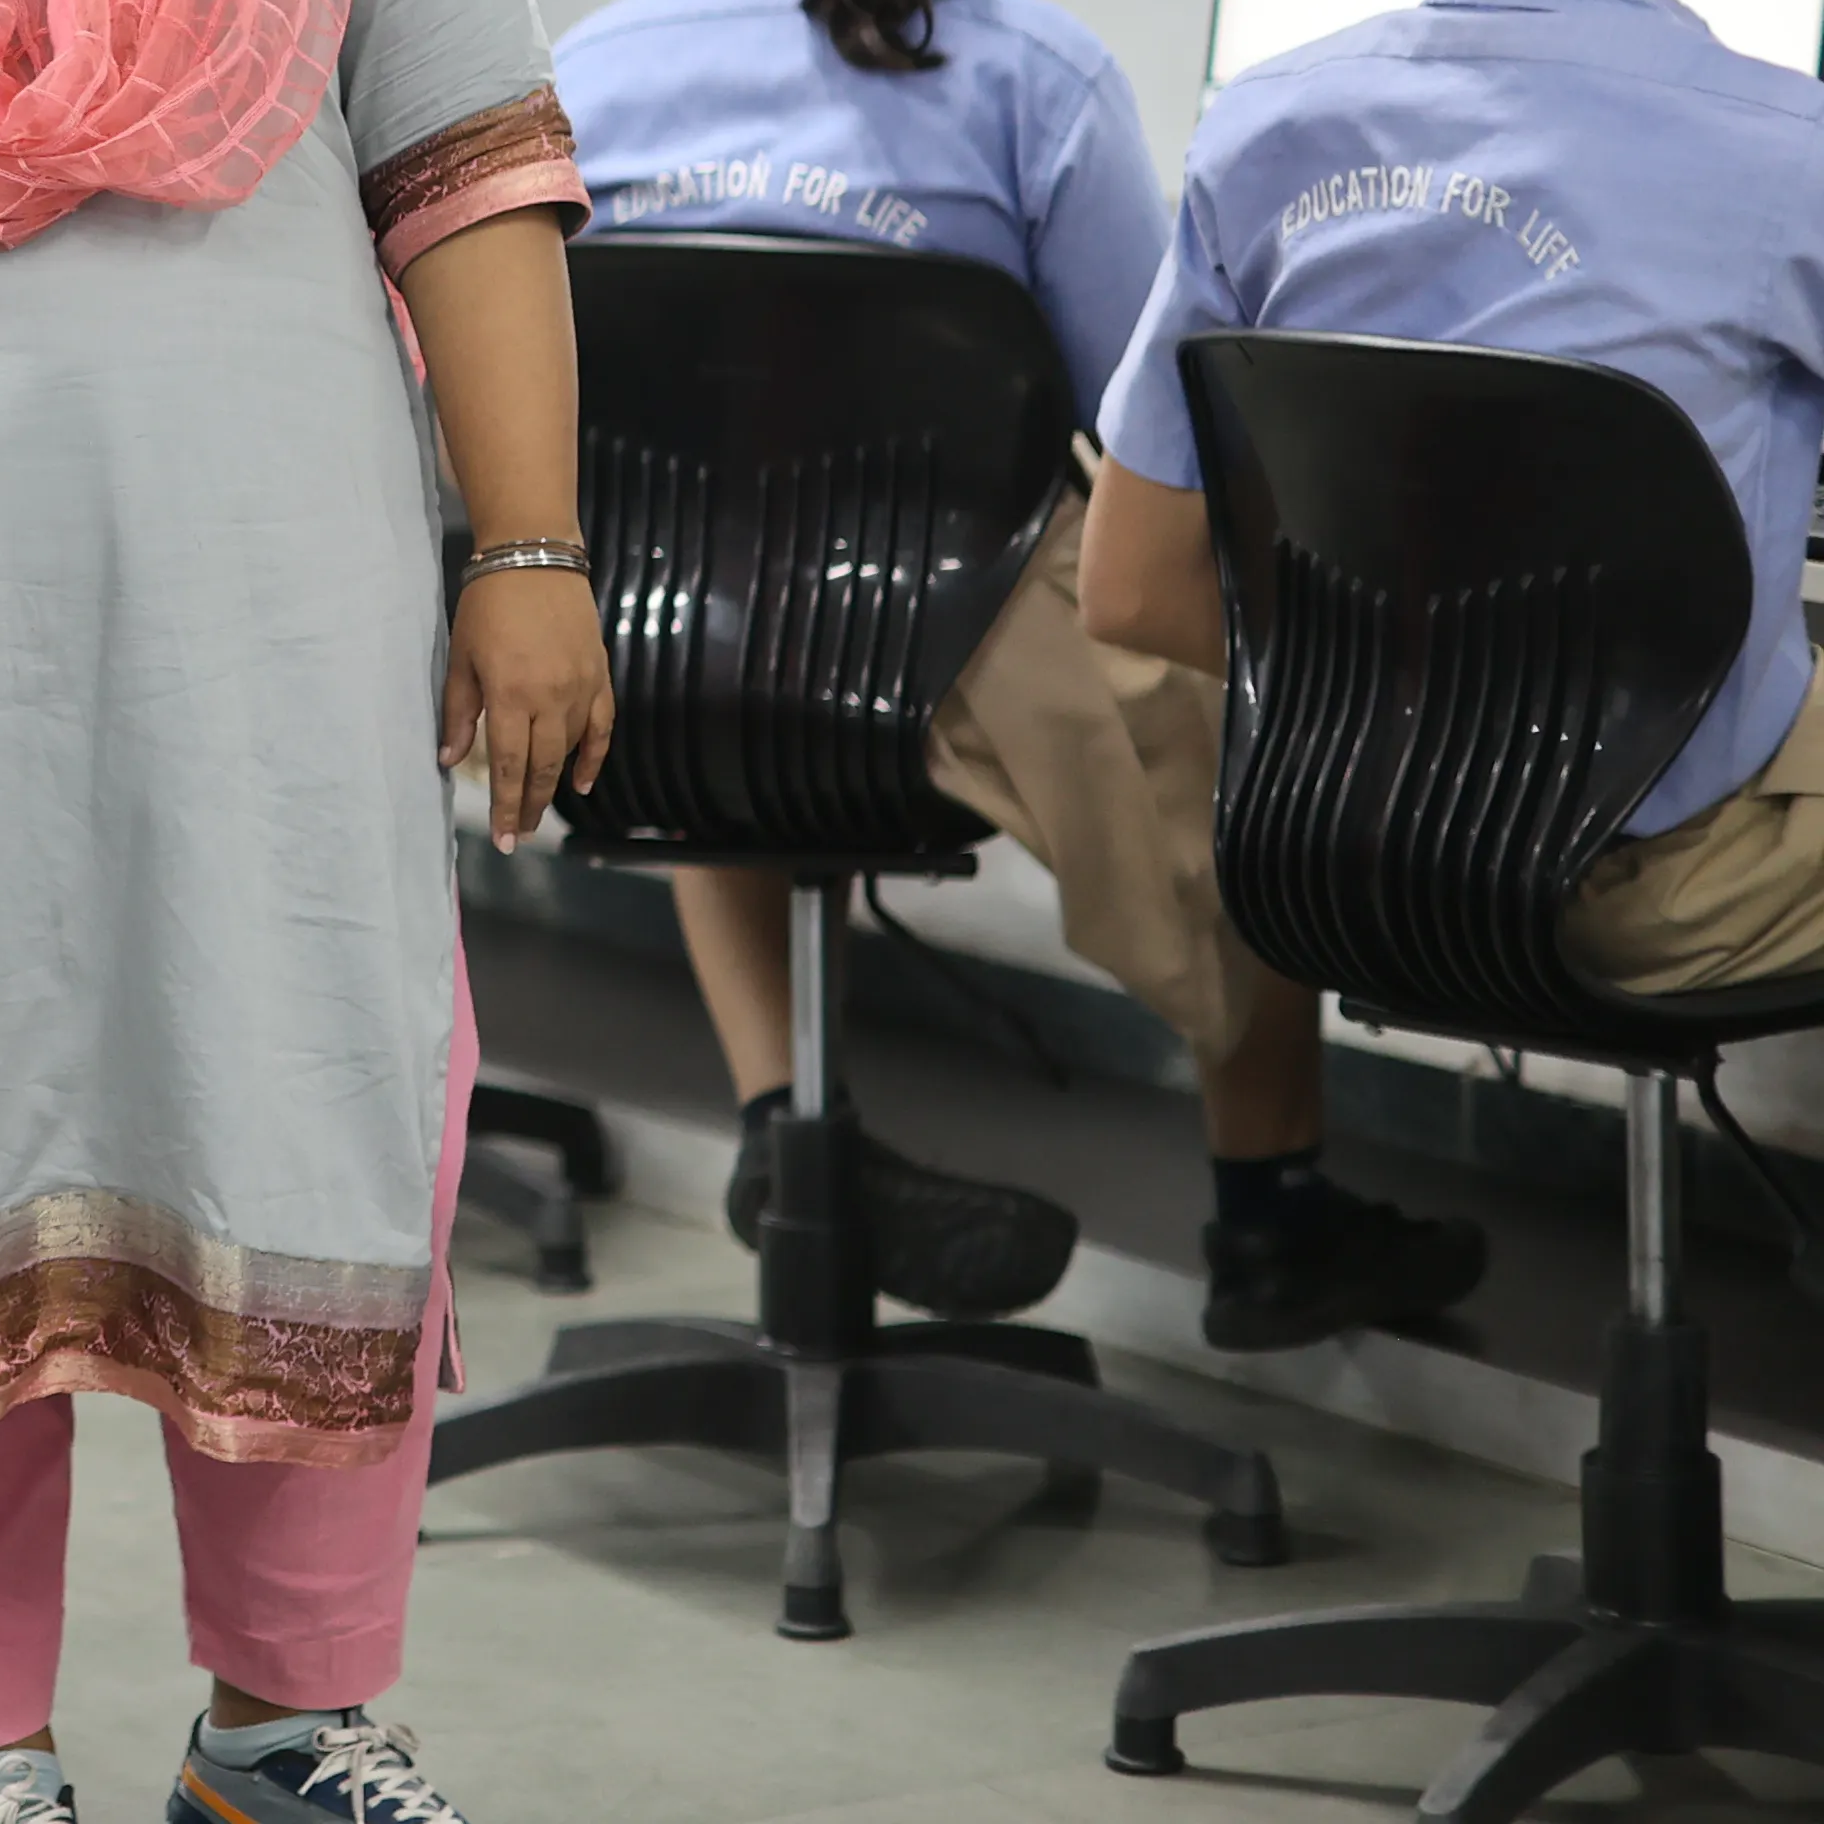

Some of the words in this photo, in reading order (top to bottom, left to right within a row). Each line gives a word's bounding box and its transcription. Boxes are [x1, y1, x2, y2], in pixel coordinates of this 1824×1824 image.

[612, 150, 772, 225] EDUCATION
[783, 161, 850, 216] FOR
[855, 187, 929, 249] LIFE
[1280, 164, 1434, 241] EDUCATION
[1439, 170, 1512, 228] FOR
[1516, 208, 1582, 282] LIFE
